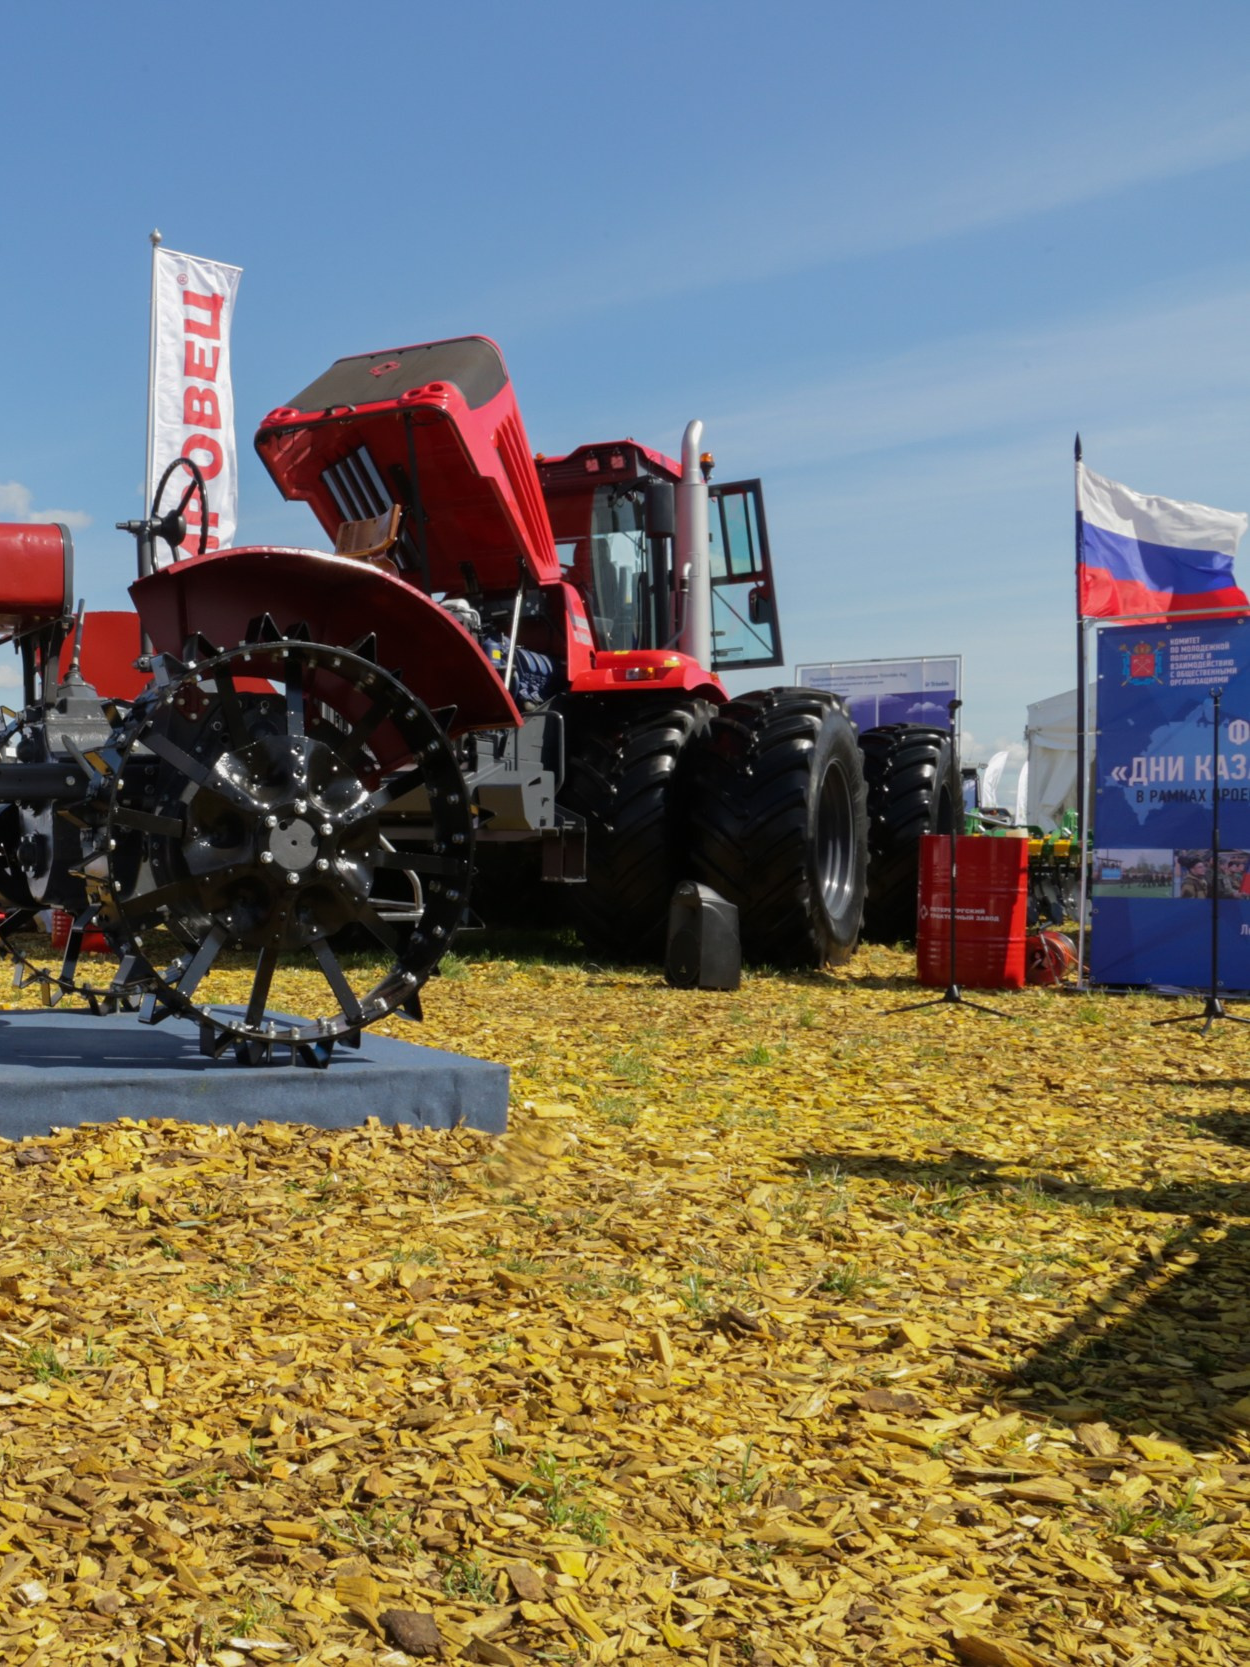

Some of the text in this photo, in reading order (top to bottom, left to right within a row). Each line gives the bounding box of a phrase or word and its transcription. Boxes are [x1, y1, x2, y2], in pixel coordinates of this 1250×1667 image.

[1170, 636, 1200, 646] КОМИТЕТ
[1170, 653, 1204, 662] ПОЛИТИКЕ
[1170, 659, 1234, 670] ВЗАИМОДЕЙСТВИЮ
[1111, 753, 1250, 787] «ДНИ КАЗ
[1136, 789, 1145, 803] В
[1150, 788, 1207, 803] РАМКАХ
